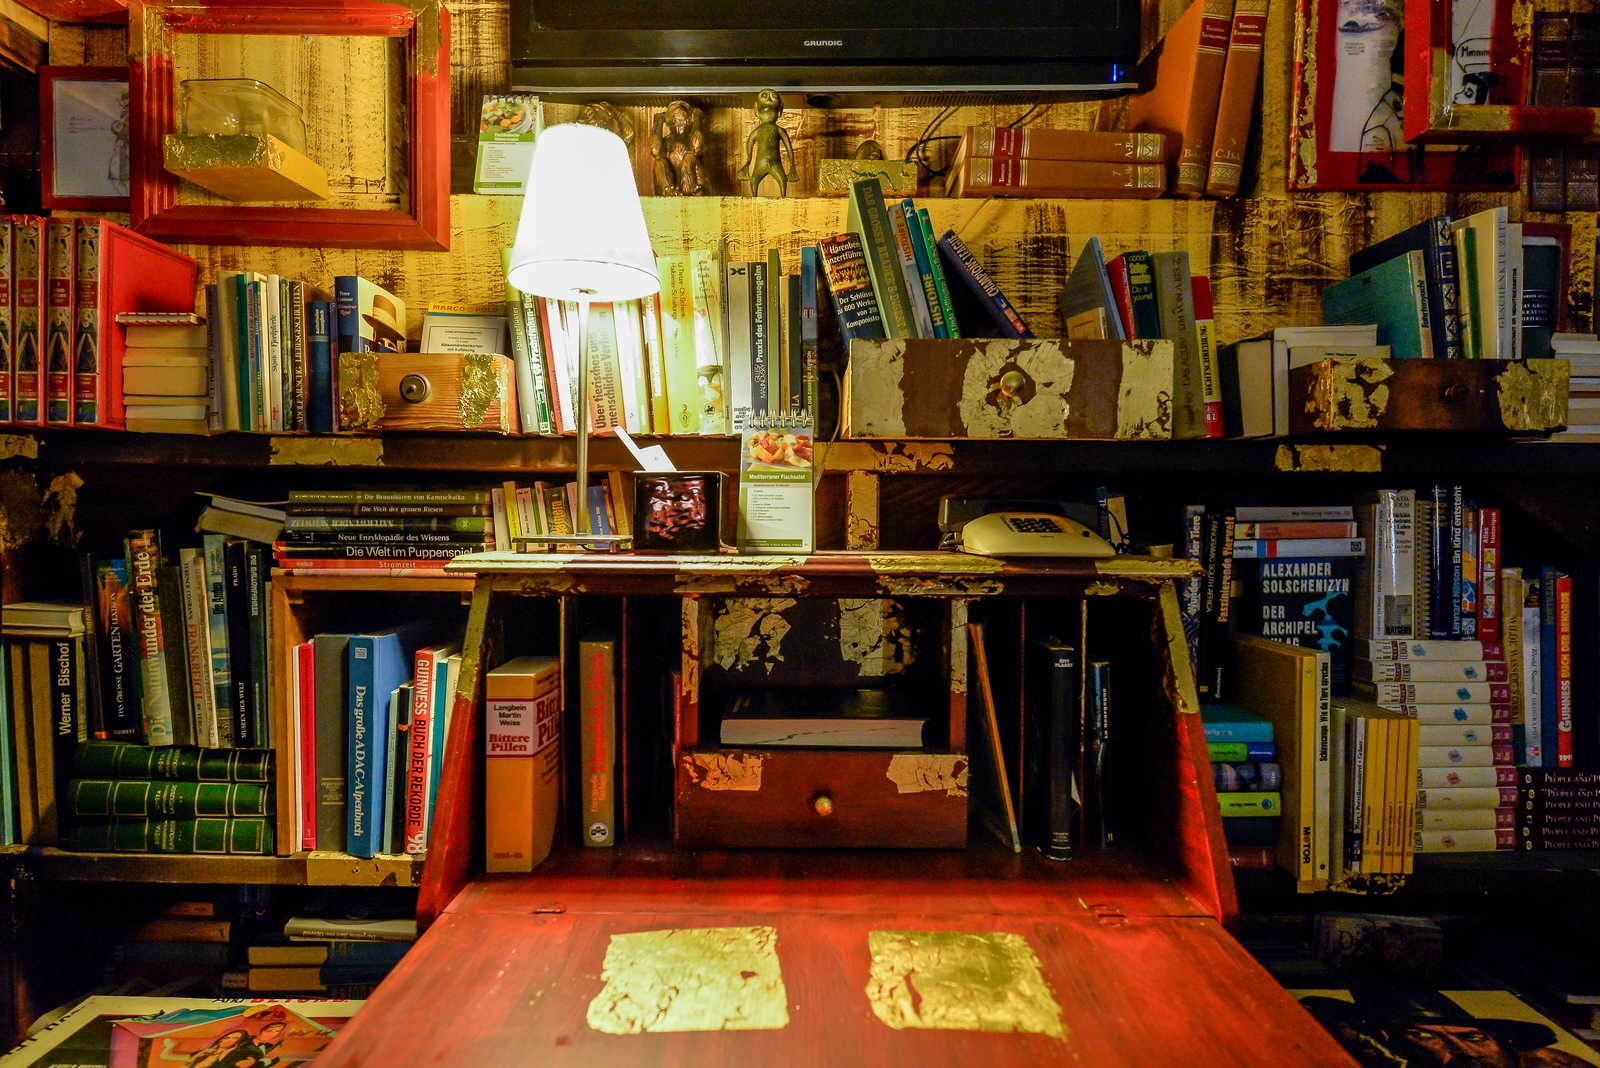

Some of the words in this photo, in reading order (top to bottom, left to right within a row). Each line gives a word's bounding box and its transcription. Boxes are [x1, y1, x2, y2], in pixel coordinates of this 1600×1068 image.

[863, 186, 875, 205] DAS
[867, 207, 885, 244] GROSSE
[896, 222, 913, 262] HISTOIRE
[947, 233, 971, 262] LEAGUE
[878, 245, 897, 292] READER'S
[1172, 257, 1181, 265] Z
[965, 259, 999, 297] CHAMPIONS
[1174, 267, 1182, 283] BIS
[922, 273, 944, 326] HISTOIRE
[1175, 284, 1183, 292] A
[1498, 251, 1506, 328] GESCHENKTE
[433, 304, 465, 312] MARCO
[839, 297, 850, 305] Der
[844, 303, 856, 312] 600
[890, 294, 906, 327] DIGEST
[1175, 292, 1184, 313] VON
[293, 285, 301, 362] LIEBESGESCHICHTEN
[512, 307, 523, 351] Föhngeflüster
[589, 333, 598, 353] und
[755, 339, 764, 363] Praxis
[1200, 326, 1214, 396] RECHTSCHREIBUNG
[295, 366, 303, 398] MUSCHG
[590, 354, 605, 402] tierisches
[1182, 369, 1191, 387] DAS
[601, 361, 619, 428] menschliches
[296, 399, 304, 424] ADOLF
[594, 402, 607, 429] Über
[1454, 485, 1462, 526] entsteht
[359, 533, 404, 542] Enzyklopädie
[1190, 515, 1200, 539] Tiere
[1223, 516, 1235, 557] Tierwelt
[1453, 528, 1461, 548] Kind
[346, 546, 364, 557] Die
[366, 546, 391, 557] Welt
[392, 547, 406, 557] im
[1190, 540, 1200, 555] der
[1209, 520, 1218, 562] PANORAMIC
[250, 555, 258, 566] DIE
[1453, 550, 1461, 564] Ein
[135, 552, 152, 587] Erde
[183, 562, 191, 589] TERENCE
[1207, 563, 1215, 588] SOUTH
[1263, 562, 1332, 578] ALEXANDER
[1452, 565, 1460, 597] Nilsson
[211, 582, 224, 603] Anden
[250, 566, 258, 616] BALLONFAHRER
[1217, 557, 1232, 623] Faszinierende
[1262, 578, 1350, 594] SOLSCHENIZYN
[110, 592, 118, 625] LEXIKON
[139, 589, 155, 613] der
[186, 590, 194, 620] CONRAN'S
[212, 603, 224, 615] Die
[1262, 605, 1285, 620] DER
[1560, 592, 1570, 632] REKORDE
[1262, 621, 1318, 636] ARCHIPEL
[1452, 599, 1460, 634] Lennart
[1509, 617, 1517, 647] WILDE
[1560, 634, 1571, 652] DER
[111, 626, 123, 673] GARTEN
[142, 615, 164, 707] Naturwunder
[188, 623, 203, 699] FRANKREICH
[1399, 642, 1408, 659] LEXIKON
[56, 642, 70, 687] Bischof
[1401, 664, 1411, 681] LEXIKON
[1560, 653, 1571, 678] BUCH
[355, 685, 366, 709] Das
[414, 659, 430, 715] GUINNESS
[1319, 688, 1328, 701] Tiere
[1407, 684, 1416, 702] LEXIKON
[58, 693, 72, 735] Werner
[493, 704, 527, 712] Langbein
[1319, 702, 1328, 710] die
[1319, 712, 1328, 722] Wie
[1558, 680, 1572, 732] GUINNESS
[150, 713, 167, 736] Die
[354, 709, 365, 741] große
[413, 719, 427, 749] BUCH
[1103, 730, 1109, 739] La
[489, 734, 530, 743] Bittere
[491, 743, 527, 752] Pillen
[172, 749, 181, 777] LAROUSSE
[411, 751, 425, 773] DER
[354, 741, 366, 837] ADAC-Alpenbuch
[408, 776, 424, 826] REKORDE
[1545, 800, 1572, 808] PEOPLE
[1545, 815, 1572, 823] PEOPLE
[407, 830, 424, 854] '98
[1542, 828, 1569, 836] PEOPLE
[1303, 826, 1311, 864] MOTOR
[1544, 841, 1571, 849] PEOPLE
